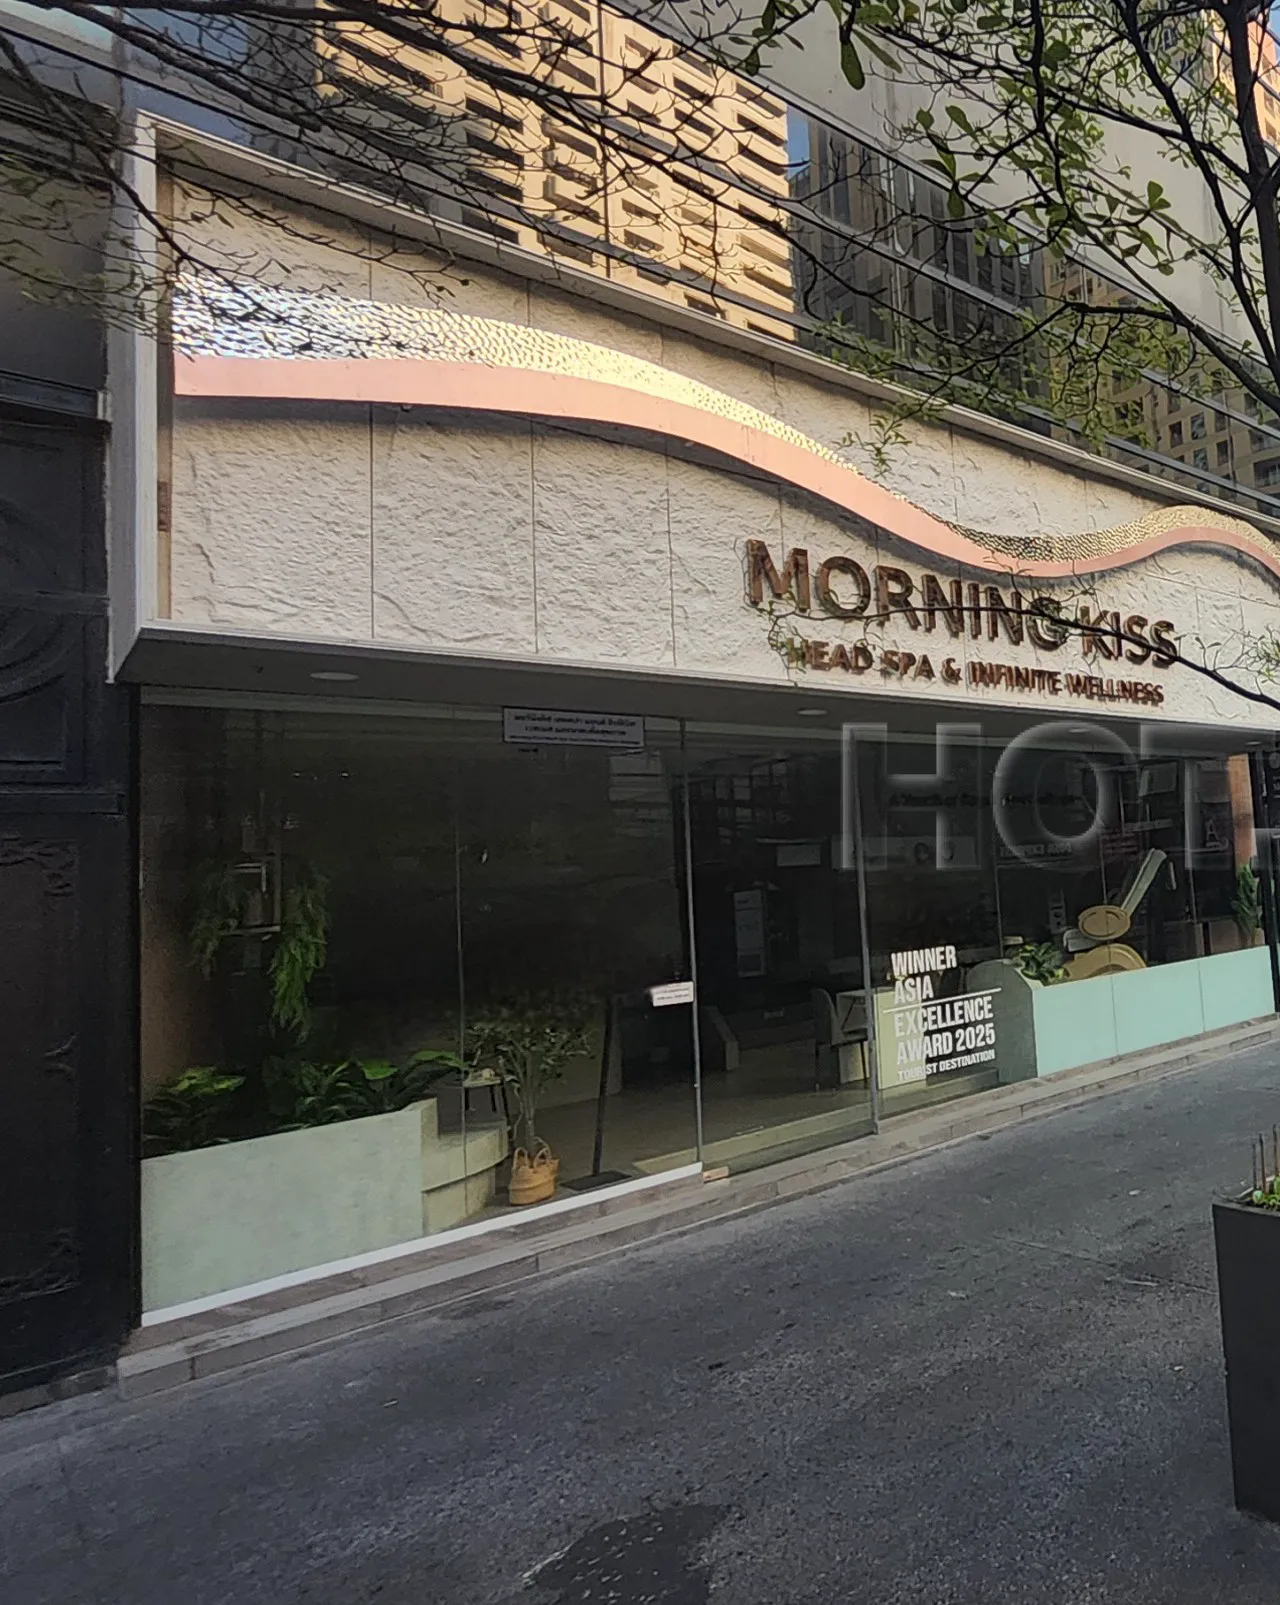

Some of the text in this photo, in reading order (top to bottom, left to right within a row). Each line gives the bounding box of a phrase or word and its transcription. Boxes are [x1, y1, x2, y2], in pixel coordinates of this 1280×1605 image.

[744, 539, 1177, 669] MORNING KISS
[786, 637, 1165, 707] HEAD SPA & INFINITE WELLNESS
[891, 945, 957, 976] WINNER
[893, 975, 934, 1005] ASIA
[893, 995, 994, 1038] EXCELLENCE
[896, 1022, 996, 1066] AWARD 2025
[897, 1049, 995, 1082] TOURIST DESTINATION
